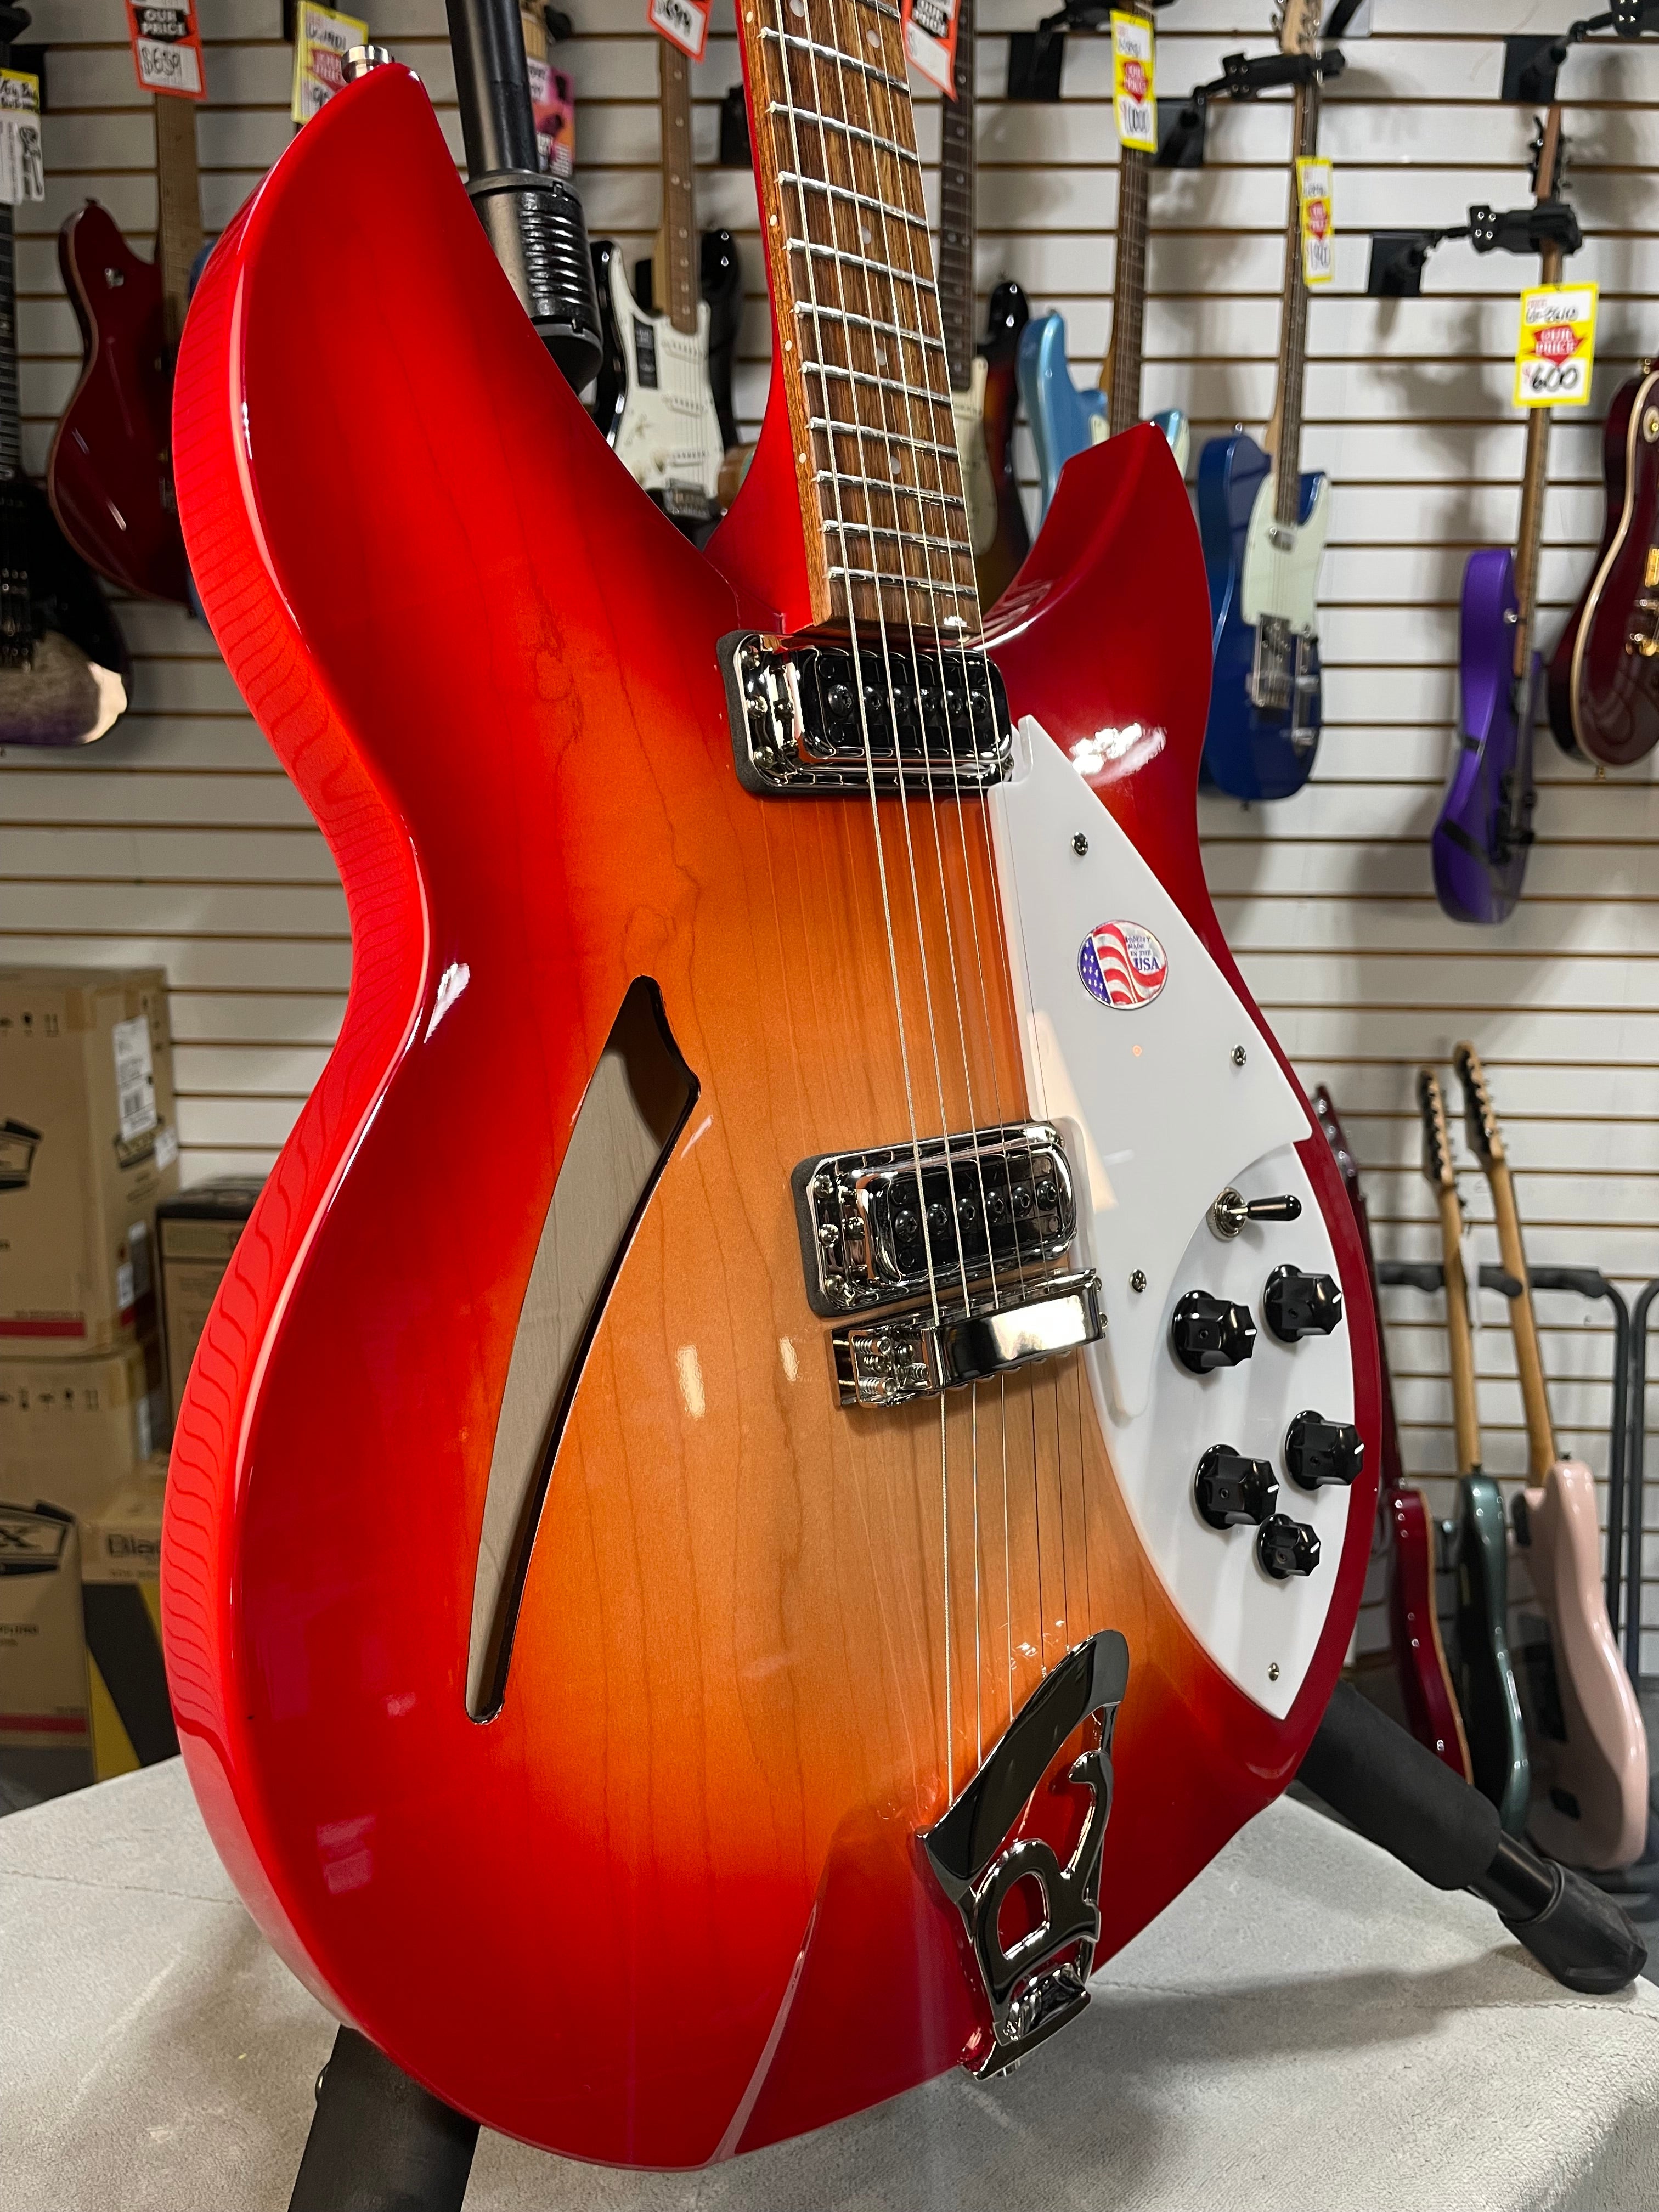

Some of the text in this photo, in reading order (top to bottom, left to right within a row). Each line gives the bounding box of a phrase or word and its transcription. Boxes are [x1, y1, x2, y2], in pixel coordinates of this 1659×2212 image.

[143, 8, 178, 22] OUR
[140, 22, 187, 36] PRICE
[1541, 327, 1573, 342] OUR
[1536, 340, 1577, 356] PRICE
[1133, 957, 1161, 970] USA
